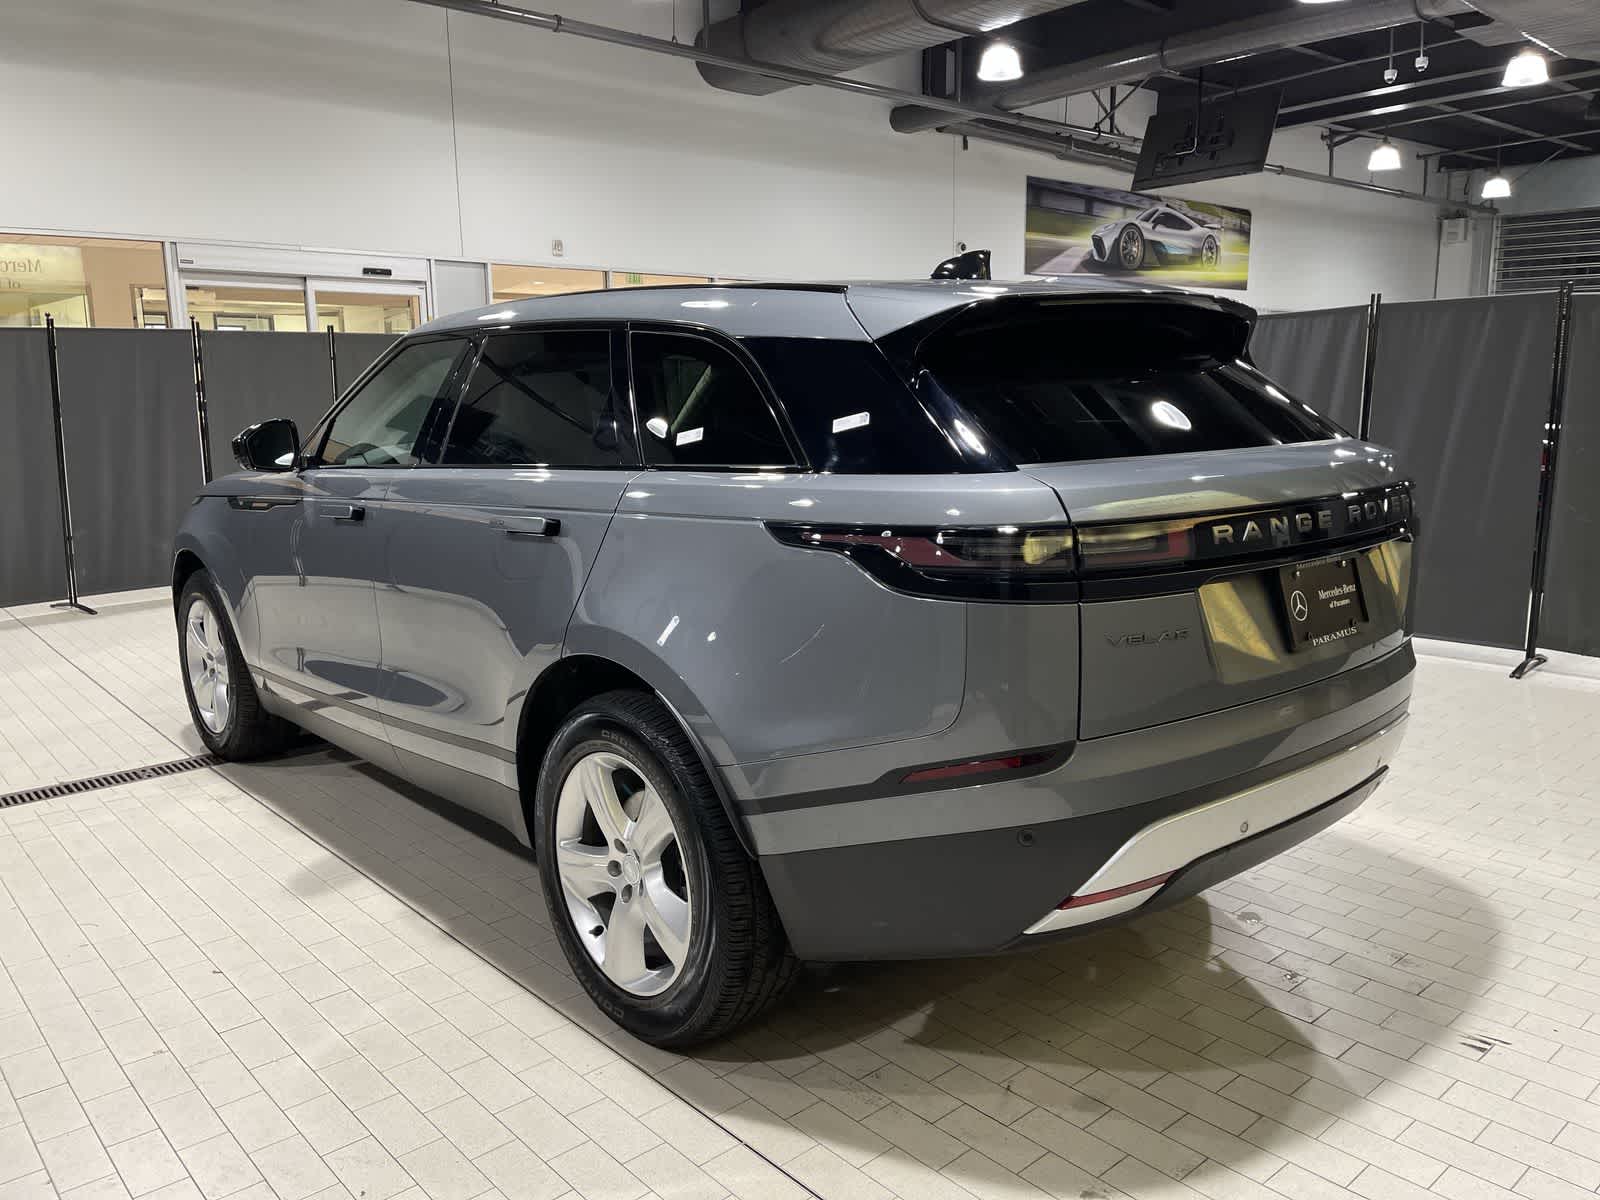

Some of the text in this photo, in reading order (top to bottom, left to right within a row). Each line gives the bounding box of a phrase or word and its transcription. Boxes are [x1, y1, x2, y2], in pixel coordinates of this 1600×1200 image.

[1211, 510, 1333, 545] RANGE
[1318, 584, 1356, 600] Mercedes-Benz
[1103, 628, 1190, 648] VELAR
[1312, 626, 1357, 646] PARAMUS
